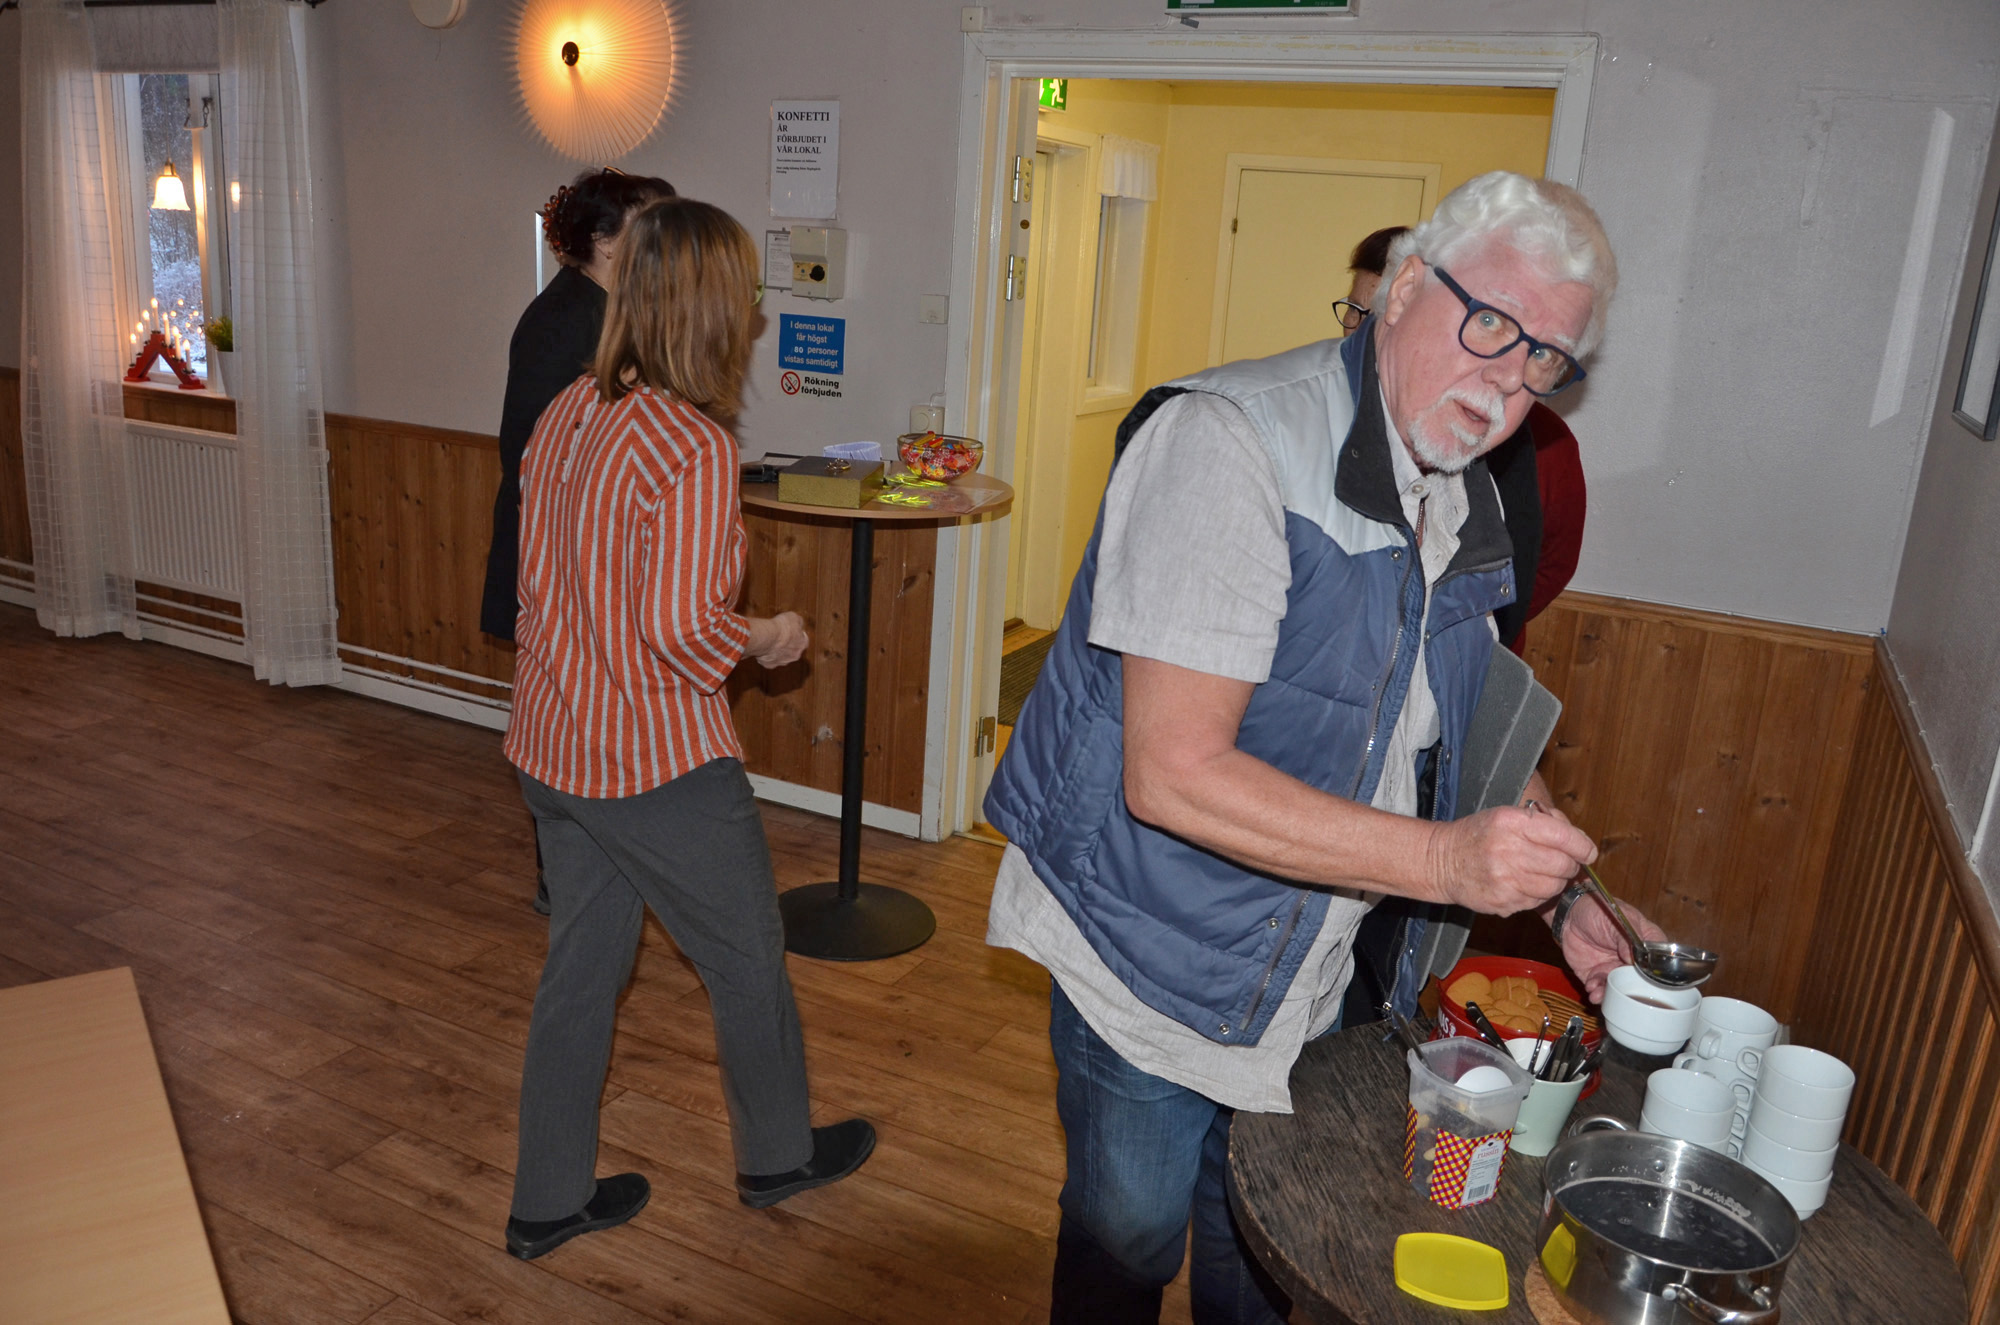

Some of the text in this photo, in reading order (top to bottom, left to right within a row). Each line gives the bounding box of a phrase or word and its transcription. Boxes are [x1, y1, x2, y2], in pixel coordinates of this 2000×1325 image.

[777, 111, 830, 121] KONFETTI
[777, 124, 788, 132] ÄR
[777, 135, 822, 143] FÖRBJUDET
[776, 145, 822, 154] VÅR LOKAL
[794, 321, 816, 331] denna
[817, 322, 834, 332] lokal
[796, 333, 827, 344] får högst
[807, 347, 839, 356] personer
[784, 355, 838, 369] vistas samtidigt
[804, 376, 839, 389] Rökning
[801, 386, 842, 398] förbjuden
